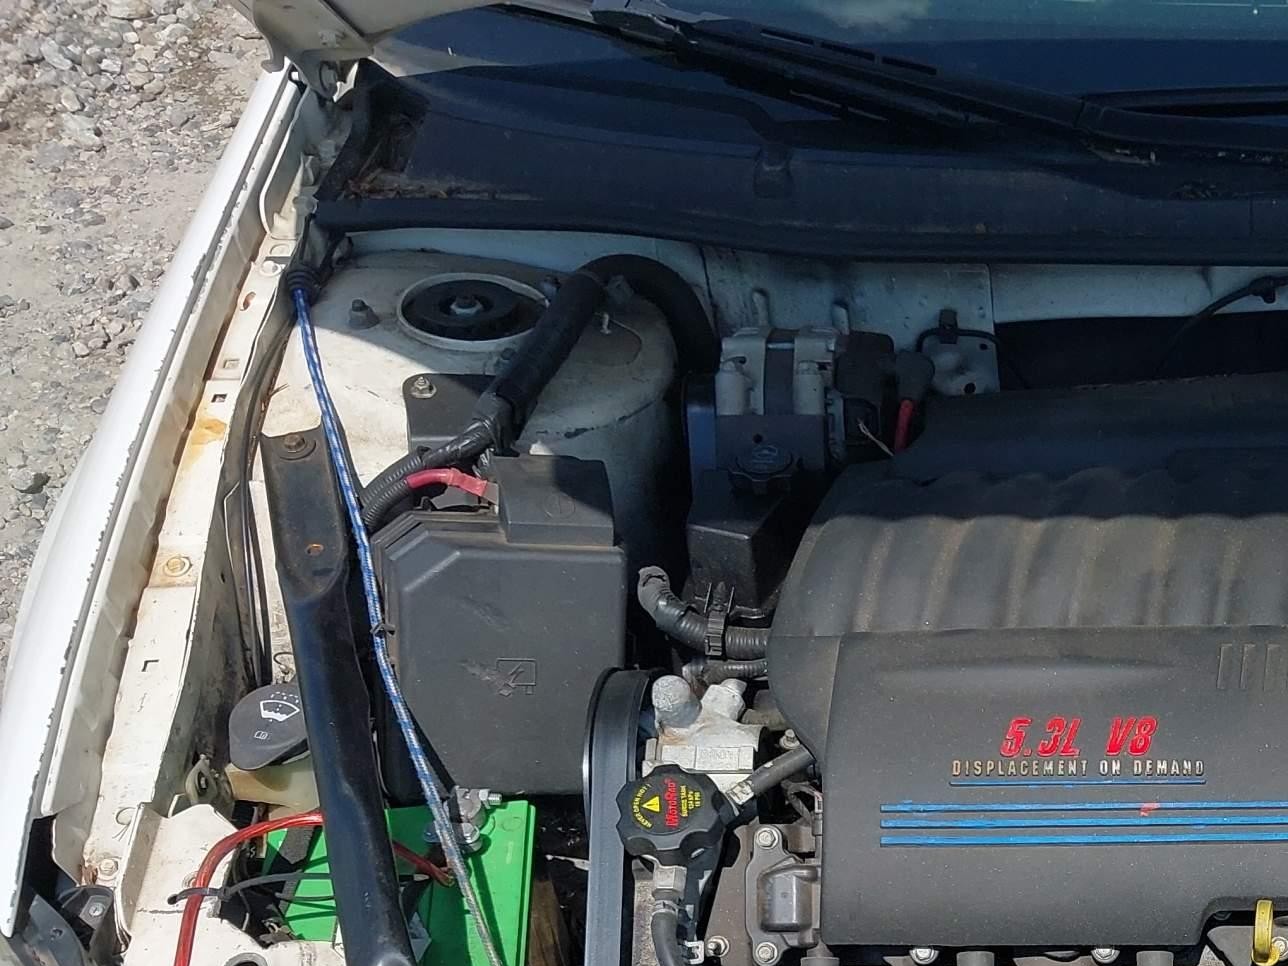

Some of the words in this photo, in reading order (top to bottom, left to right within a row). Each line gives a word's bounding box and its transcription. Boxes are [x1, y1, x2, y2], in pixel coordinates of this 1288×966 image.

[1000, 716, 1083, 758] 5.3L
[1106, 716, 1159, 757] V8
[952, 760, 1089, 777] DISPLACEMENT
[1099, 760, 1122, 776] ON
[1133, 759, 1205, 776] DEMAND
[632, 797, 641, 812] OPEN
[635, 811, 652, 828] NEVER
